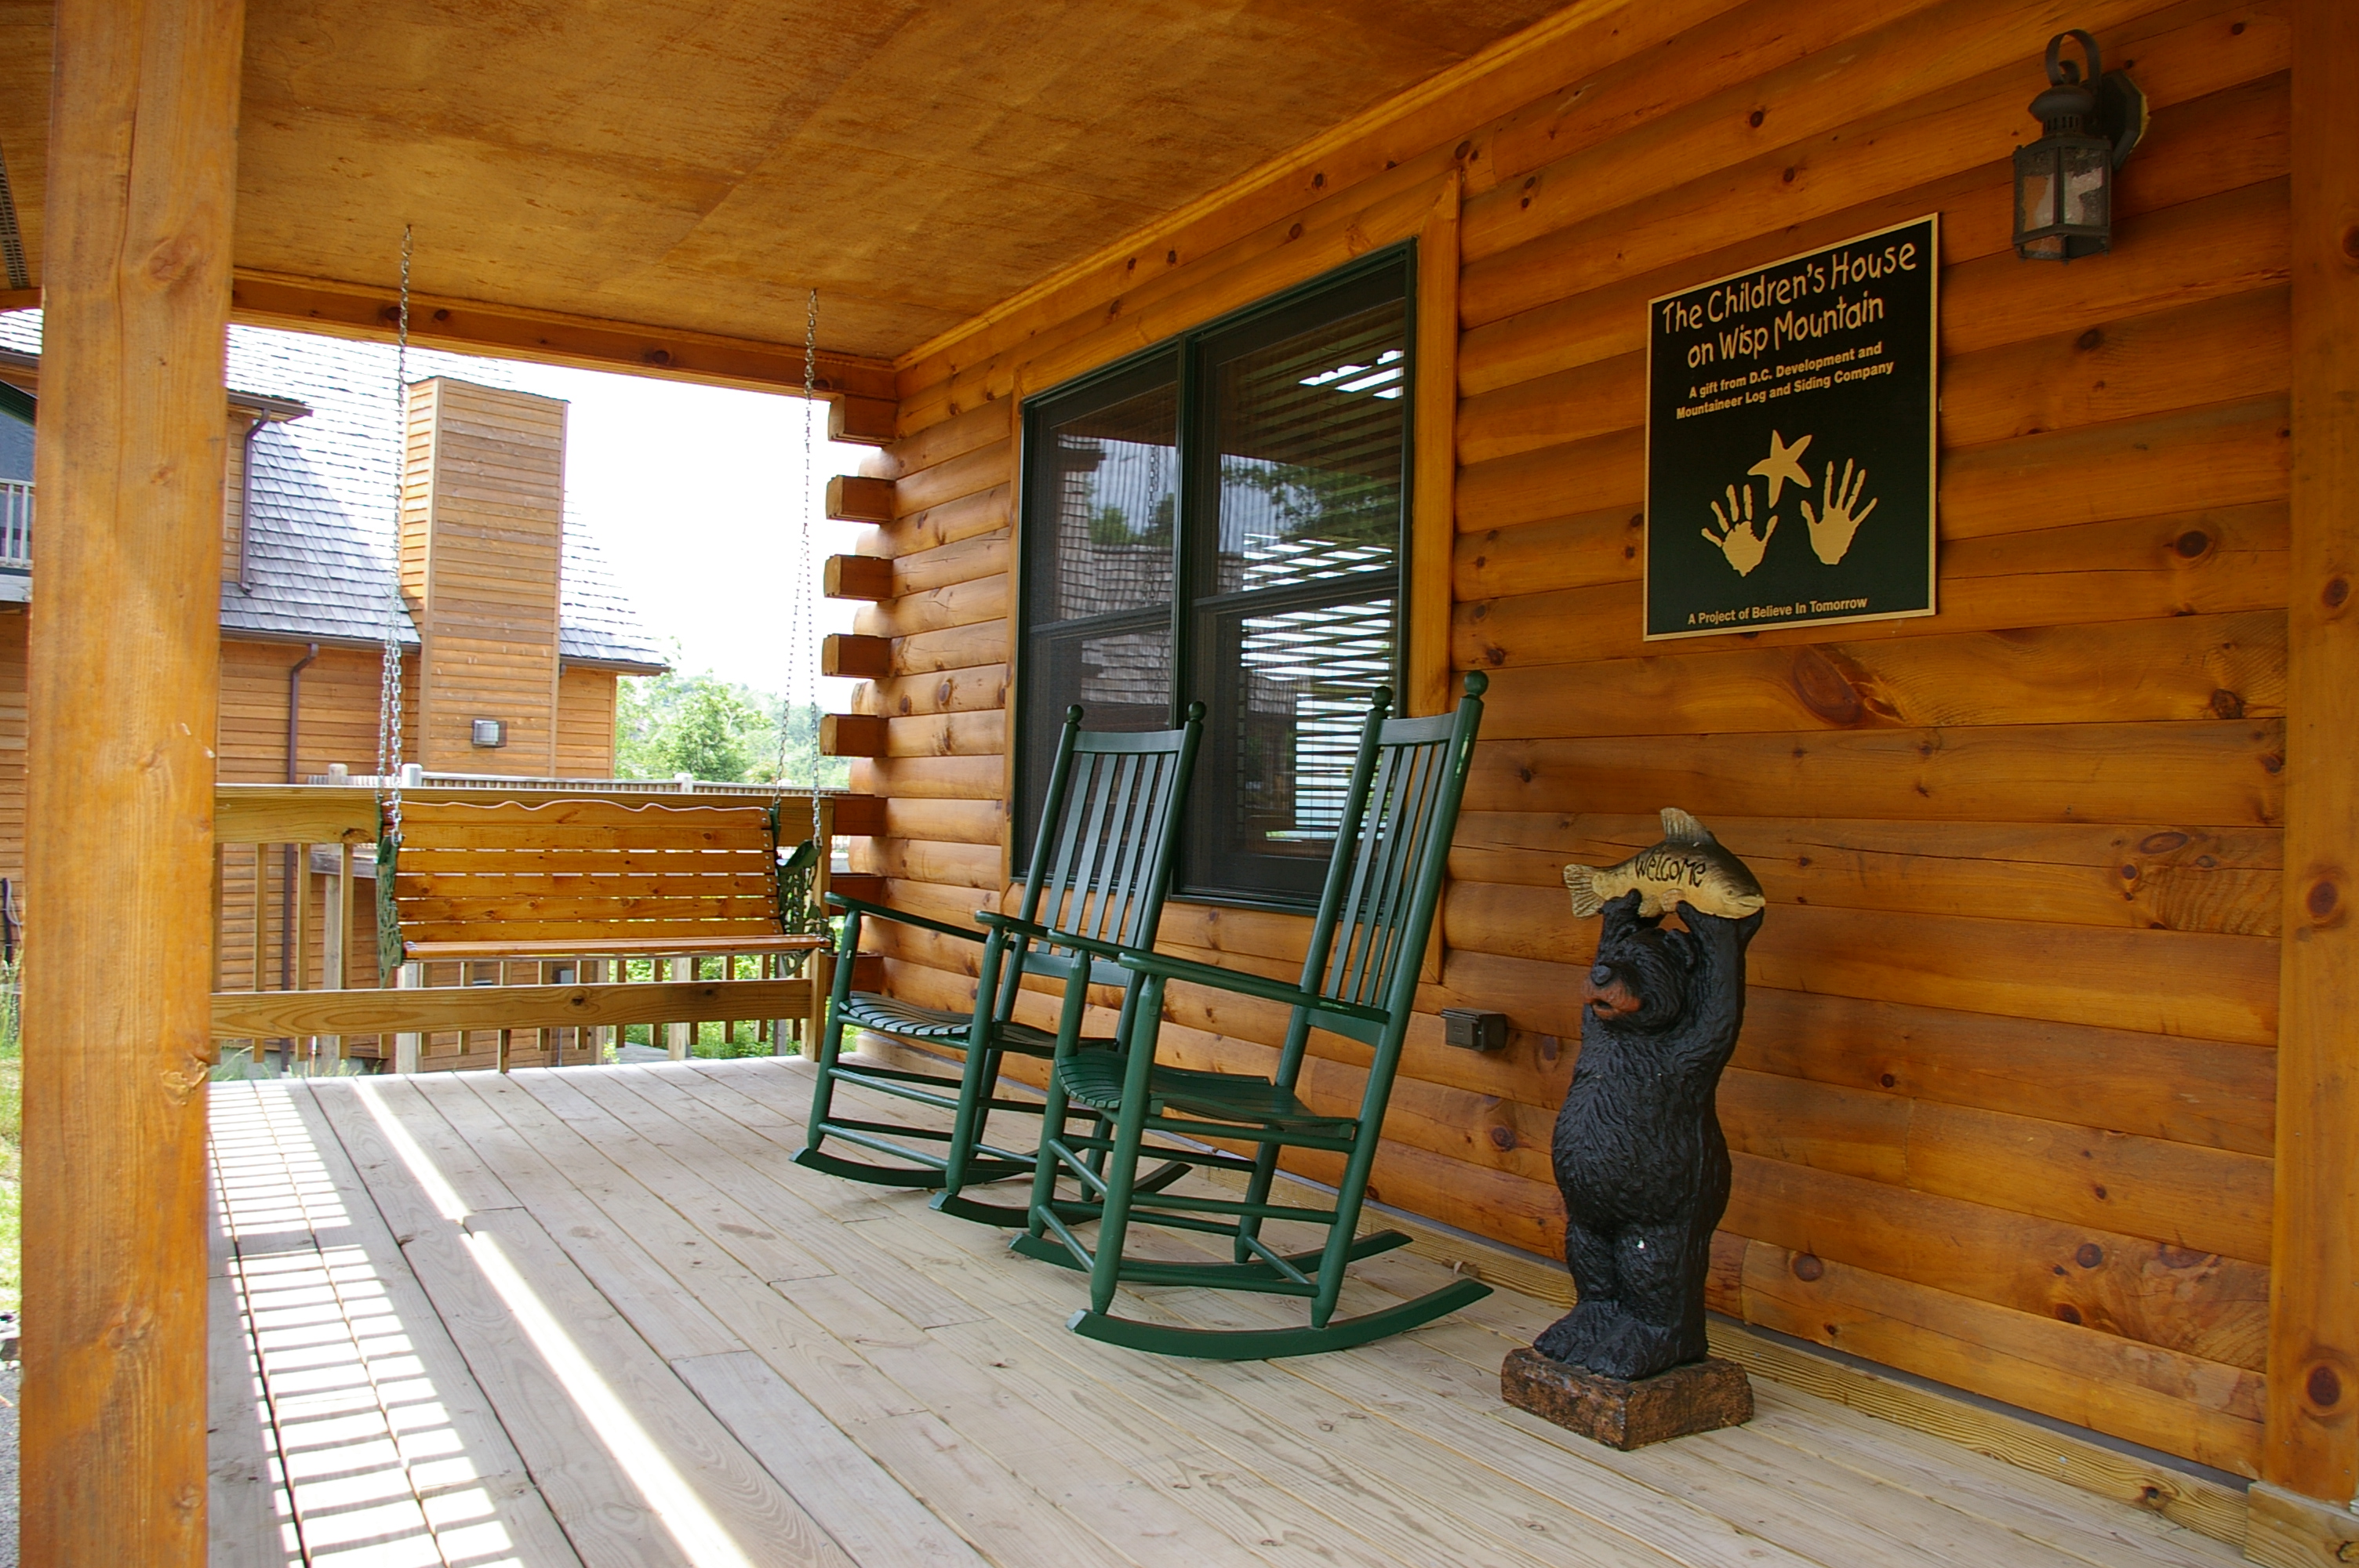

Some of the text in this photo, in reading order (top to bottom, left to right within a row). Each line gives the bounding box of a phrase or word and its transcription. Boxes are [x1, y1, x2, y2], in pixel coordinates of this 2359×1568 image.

[1662, 242, 1917, 333] The Children's House
[1687, 291, 1884, 368] on Wisp Mountain
[1676, 361, 1894, 419] Mountaineer Log and Siding Company
[1688, 342, 1882, 398] A gift from D.C. Development and
[1688, 598, 1867, 625] A Project of Believe In Tomorrow
